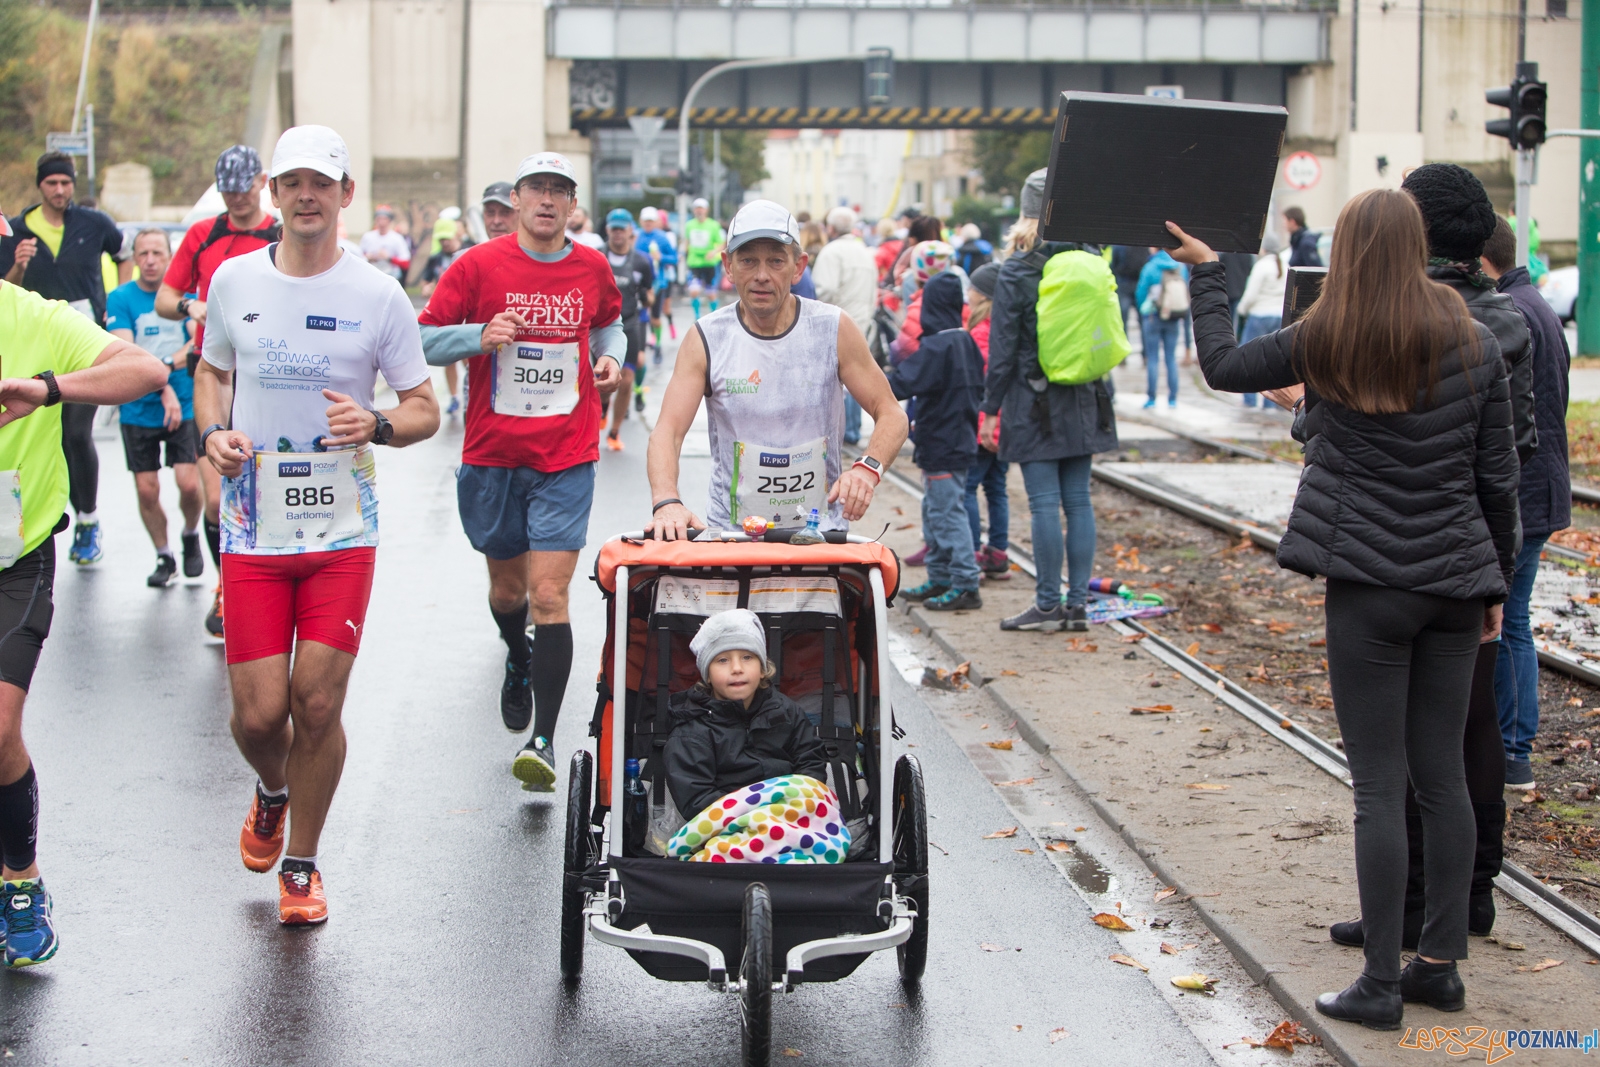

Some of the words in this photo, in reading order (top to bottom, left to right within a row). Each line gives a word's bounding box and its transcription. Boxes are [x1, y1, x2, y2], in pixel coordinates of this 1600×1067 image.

[505, 291, 571, 307] DRUŻYNA
[242, 313, 260, 323] 4F
[257, 337, 288, 350] SIŁA
[266, 351, 331, 366] ODWAGA
[258, 363, 331, 379] SZYBKOŚĆ
[513, 366, 564, 384] 3049
[725, 378, 748, 386] FIZJO
[748, 369, 762, 385] 4
[259, 381, 265, 389] 9
[520, 387, 555, 395] Mirosław
[726, 385, 759, 394] FAMILY
[757, 470, 815, 494] 2522
[285, 485, 335, 507] 886
[769, 495, 806, 507] Ryszard
